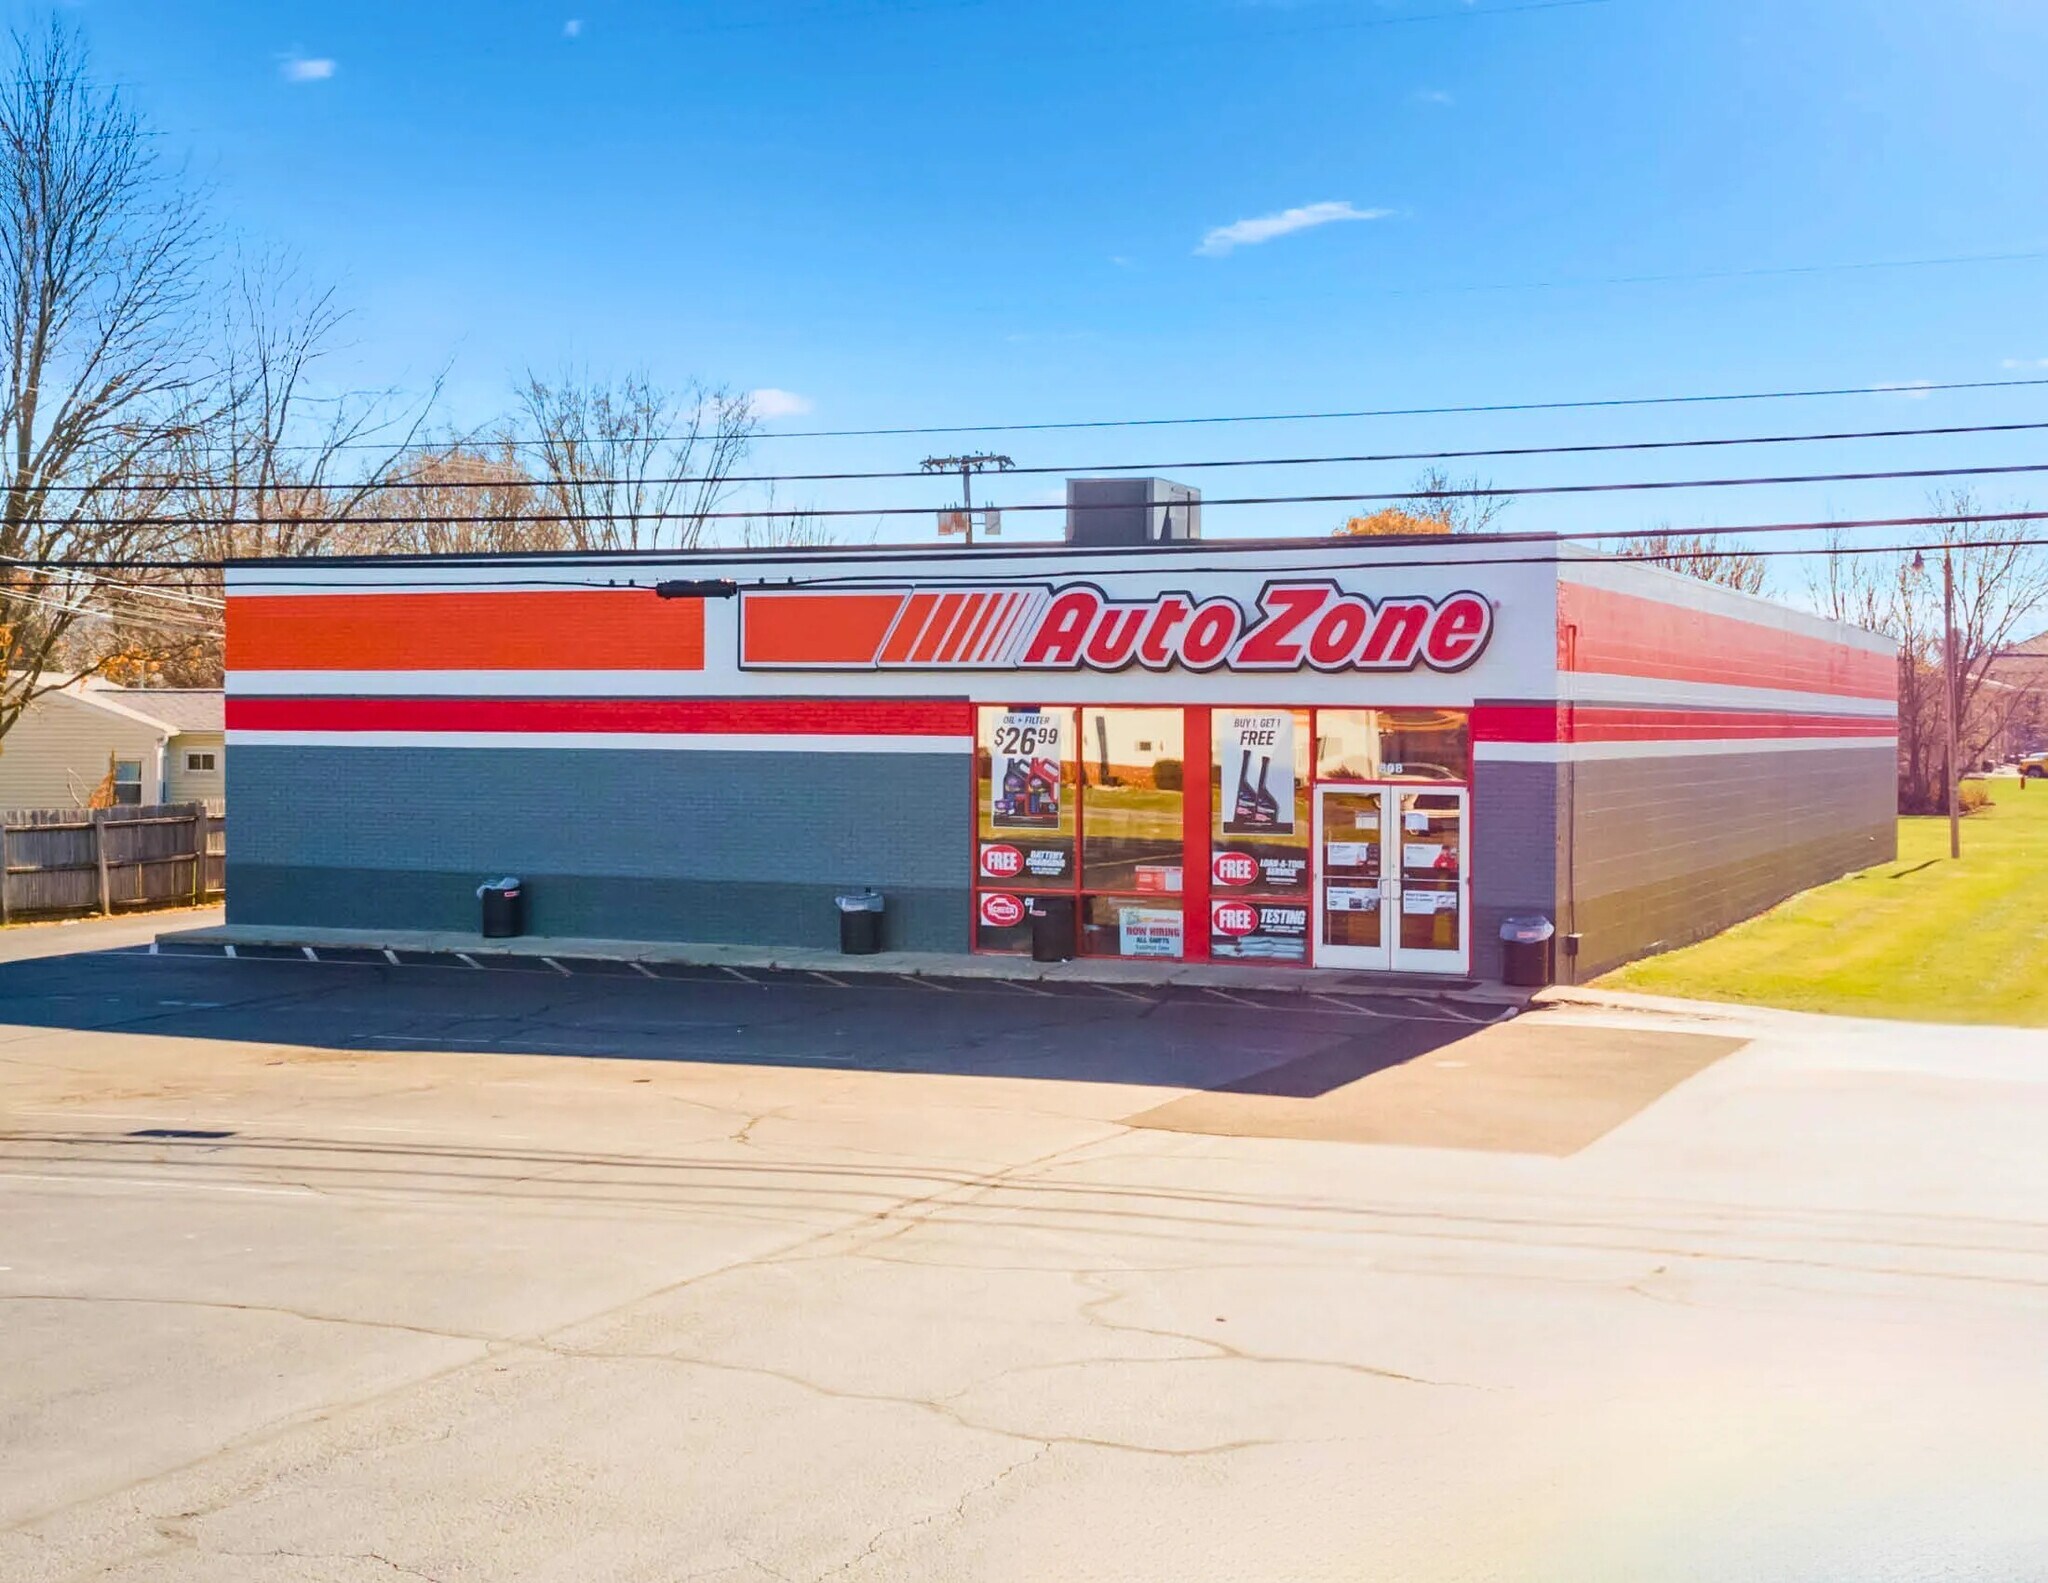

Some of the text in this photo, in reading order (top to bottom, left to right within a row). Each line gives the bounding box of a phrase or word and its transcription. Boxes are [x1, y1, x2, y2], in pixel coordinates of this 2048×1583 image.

[1003, 715, 1015, 725] OIL
[1024, 716, 1050, 725] FILTER
[1234, 718, 1251, 728] BUY
[1260, 719, 1275, 728] GET
[1240, 730, 1275, 746] FREE
[987, 851, 1018, 871] FREE
[1219, 859, 1252, 879] FREE
[1219, 909, 1252, 929] FREE
[1260, 909, 1306, 925] TESTING
[1126, 926, 1180, 937] NOW HIRING
